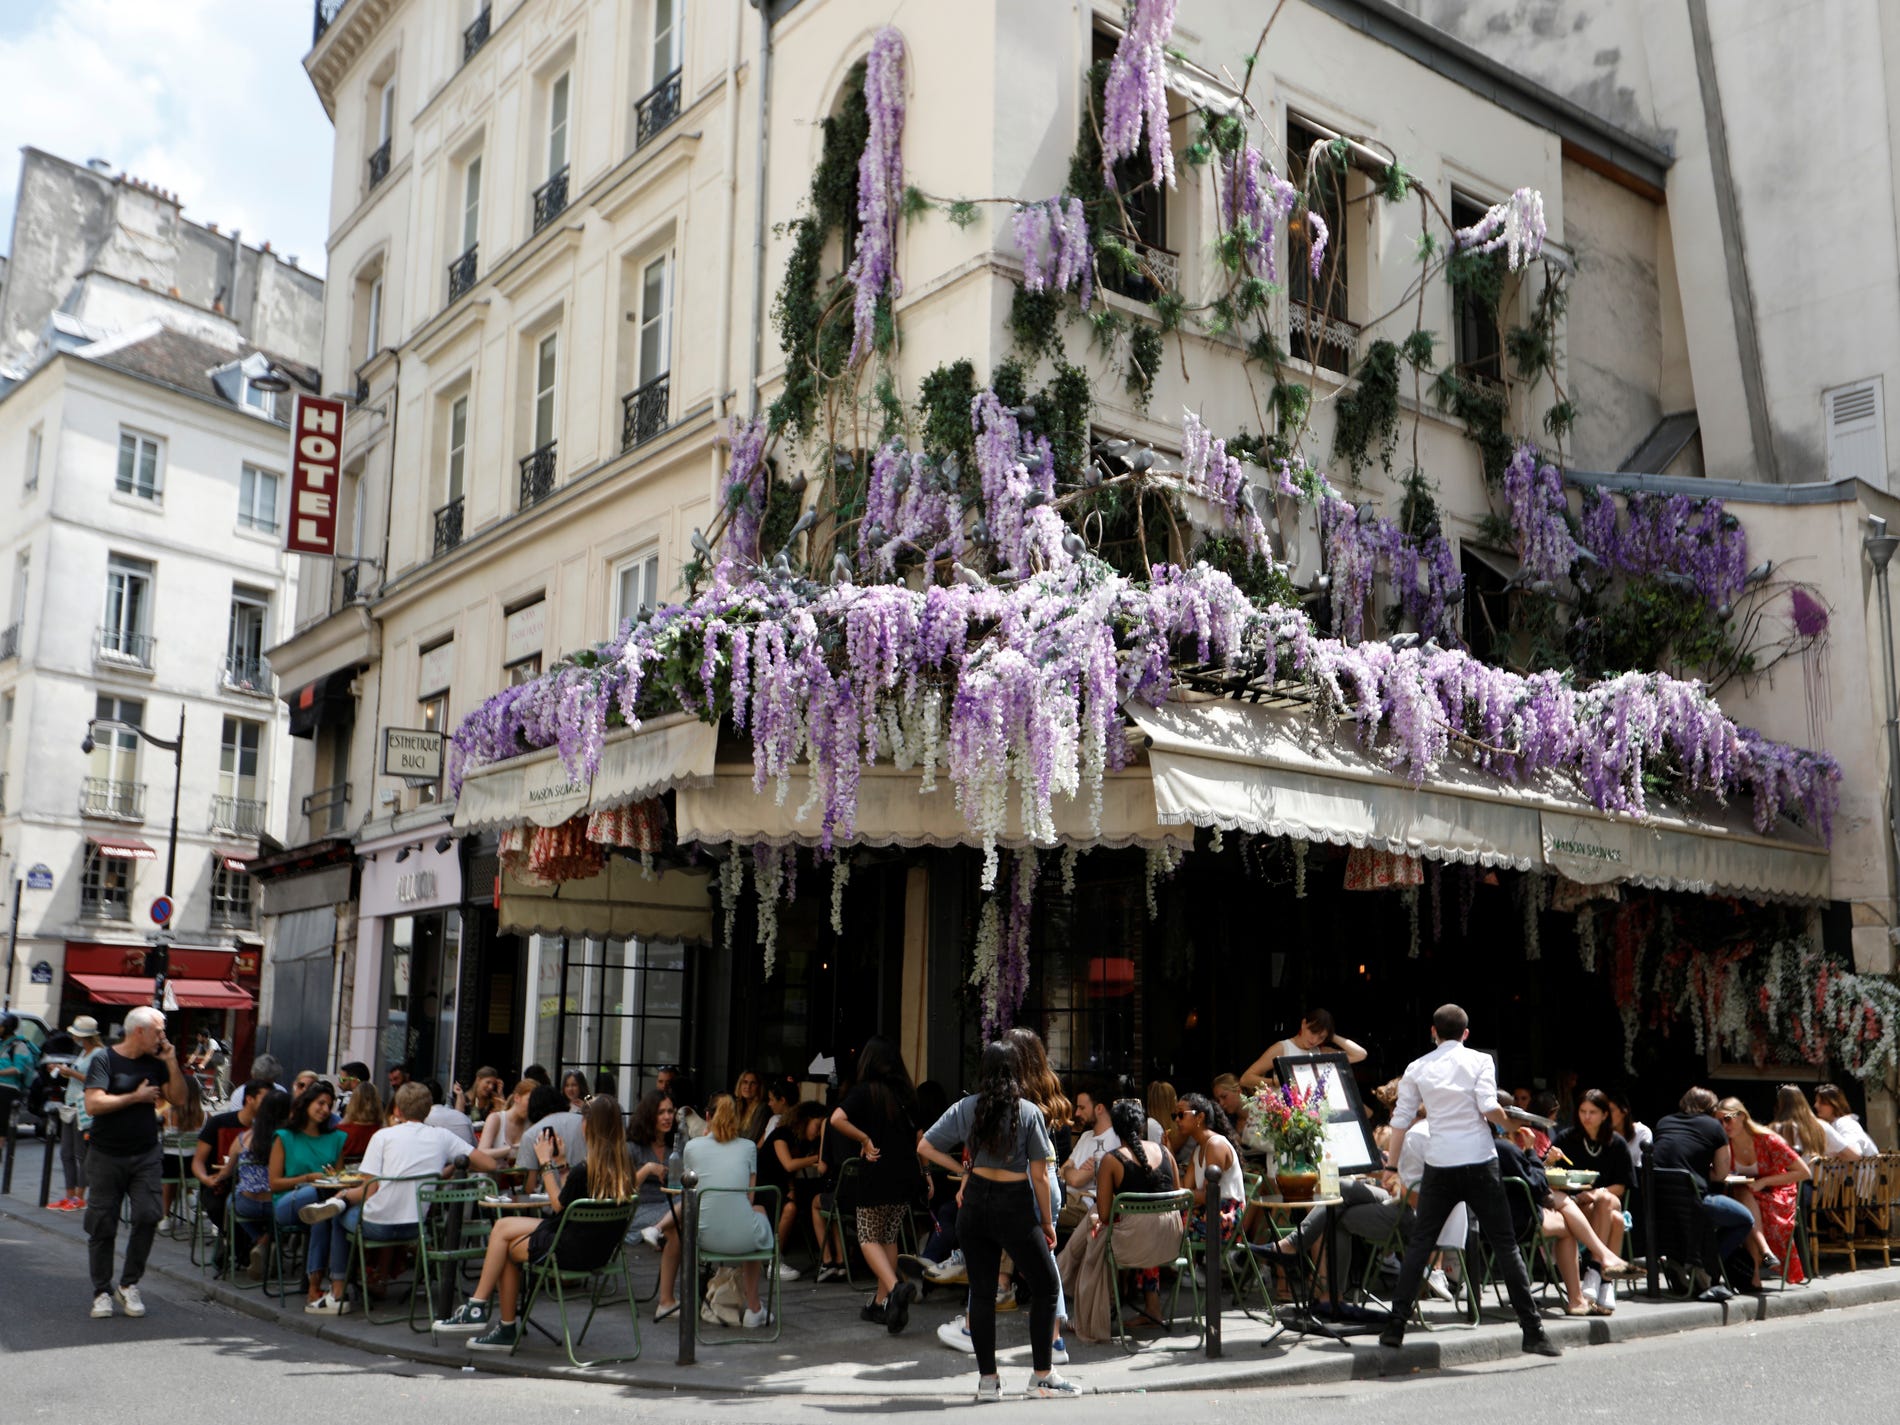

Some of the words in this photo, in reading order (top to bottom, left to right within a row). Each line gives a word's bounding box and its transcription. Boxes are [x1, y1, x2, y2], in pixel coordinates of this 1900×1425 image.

[297, 405, 337, 546] HOTEL
[389, 734, 440, 752] ESTHETIQUE
[401, 753, 425, 769] BUCI
[529, 785, 554, 801] MAISON
[1553, 838, 1585, 855] MAISON
[1586, 844, 1621, 861] SAUVAGE
